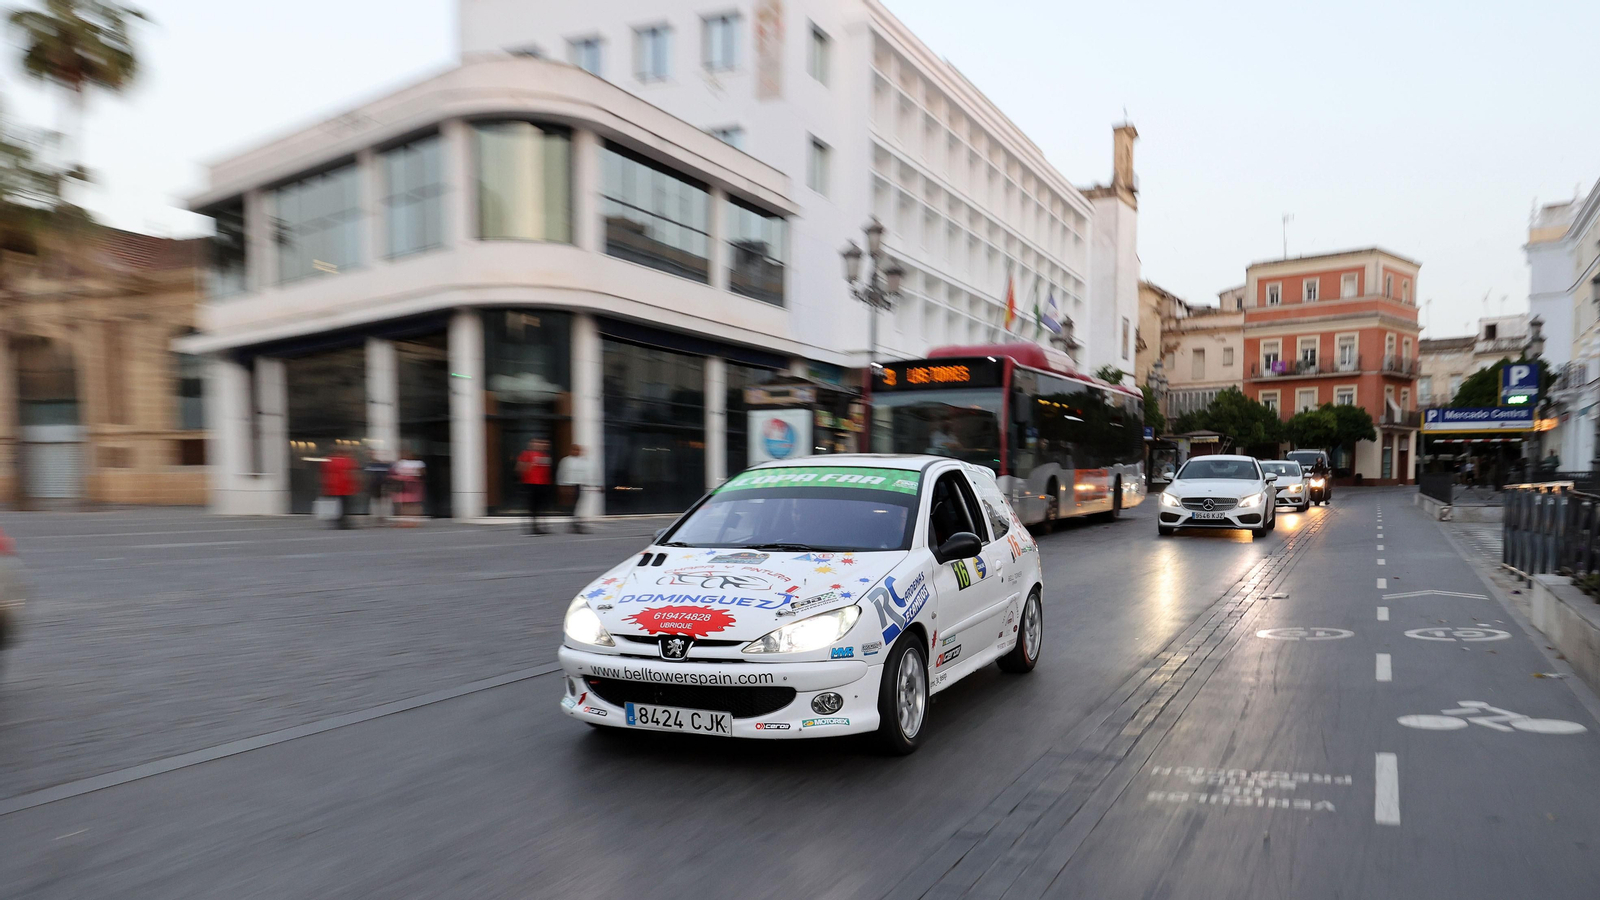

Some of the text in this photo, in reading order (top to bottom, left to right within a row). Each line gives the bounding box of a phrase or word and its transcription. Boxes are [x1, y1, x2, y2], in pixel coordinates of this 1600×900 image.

[1510, 365, 1530, 386] P
[1427, 410, 1438, 422] P
[1444, 410, 1490, 420] Mercado
[1007, 534, 1022, 558] 16
[741, 565, 792, 582] PINTURA
[953, 560, 969, 588] 16
[618, 593, 783, 610] DOMINGUEZ
[653, 612, 712, 621] 619474828
[660, 622, 693, 630] UBRIQUE
[591, 665, 774, 686] www.belltowerspain.com
[639, 707, 684, 729] 8424
[691, 712, 727, 733] CJK
[814, 717, 849, 726] MOTOREX
